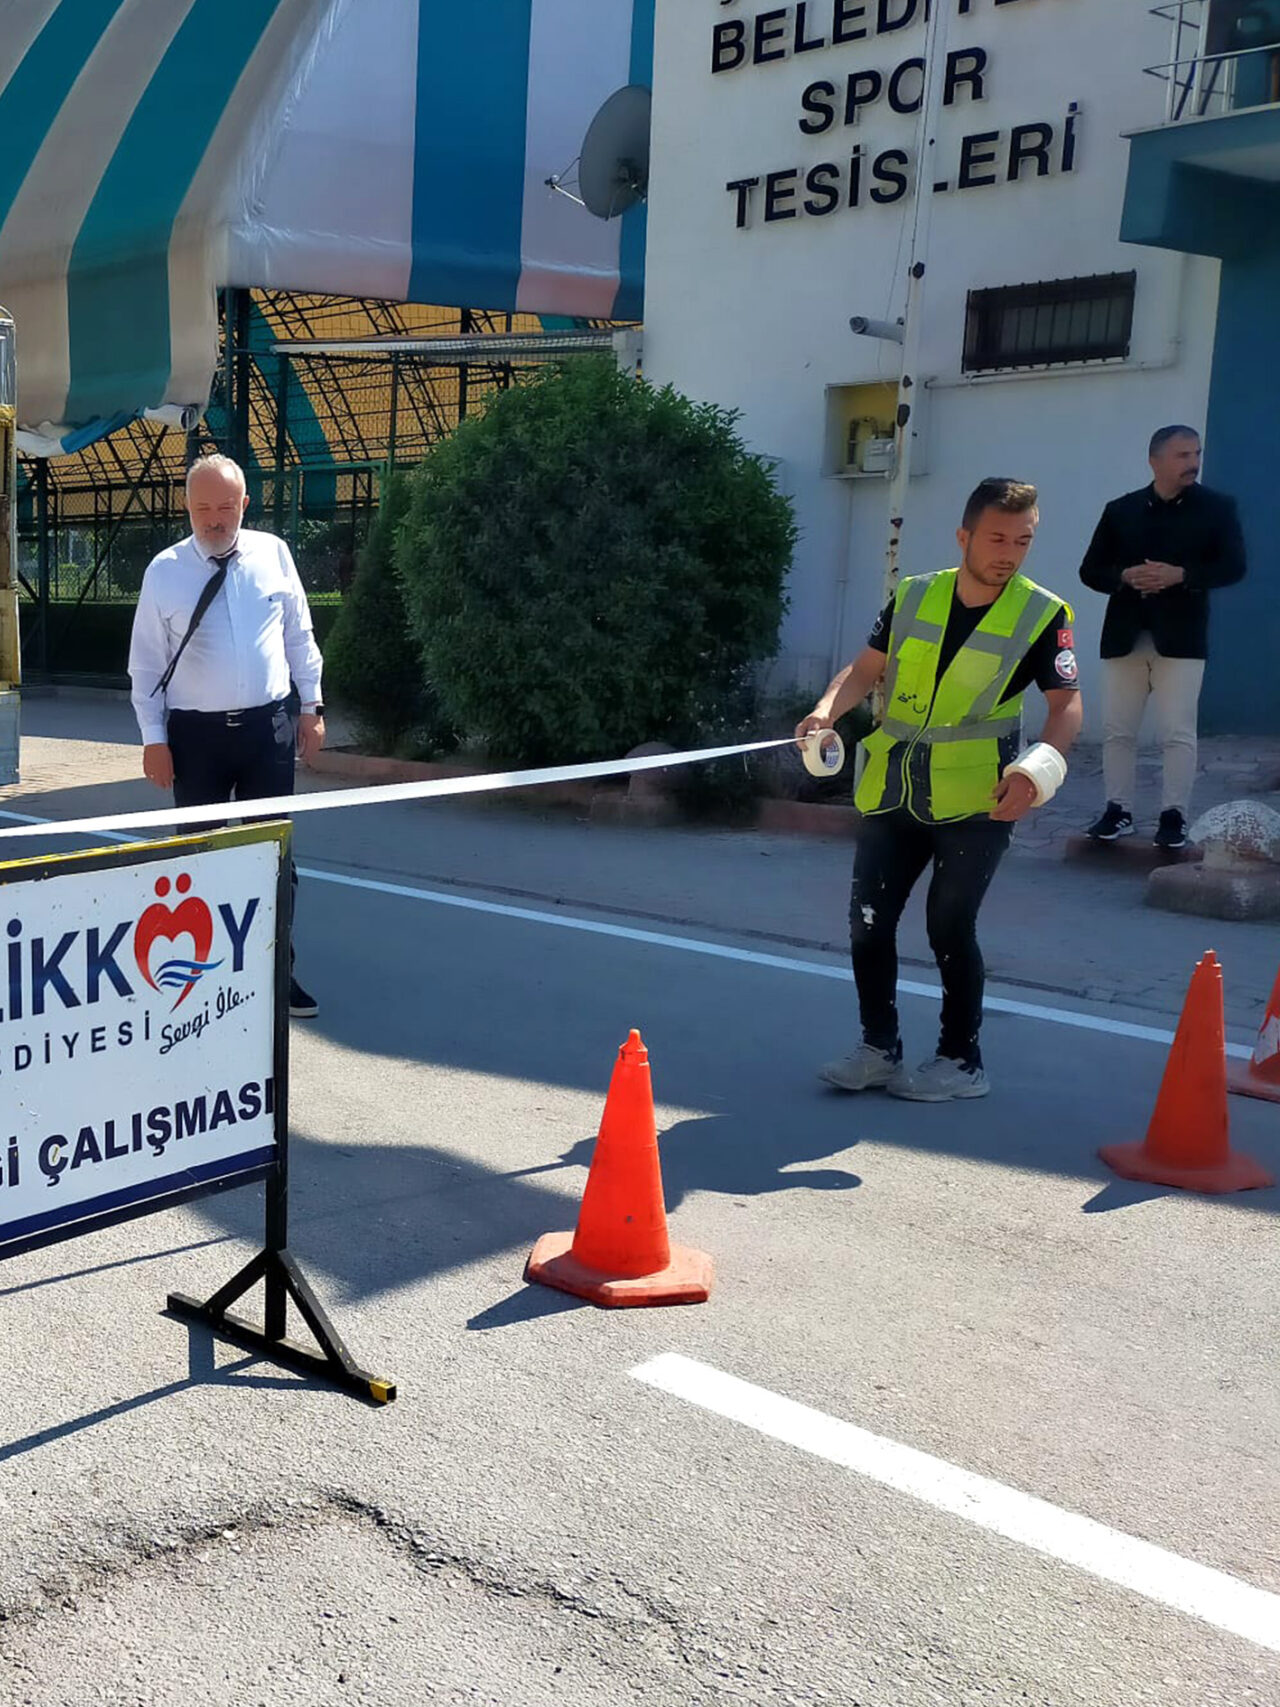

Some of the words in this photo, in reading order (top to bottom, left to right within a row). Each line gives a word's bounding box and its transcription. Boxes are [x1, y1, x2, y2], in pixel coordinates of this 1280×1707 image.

[726, 101, 1081, 230] TESİSERİ
[159, 1001, 210, 1055] Sevgi
[38, 1077, 275, 1187] ÇALIŞMASI
